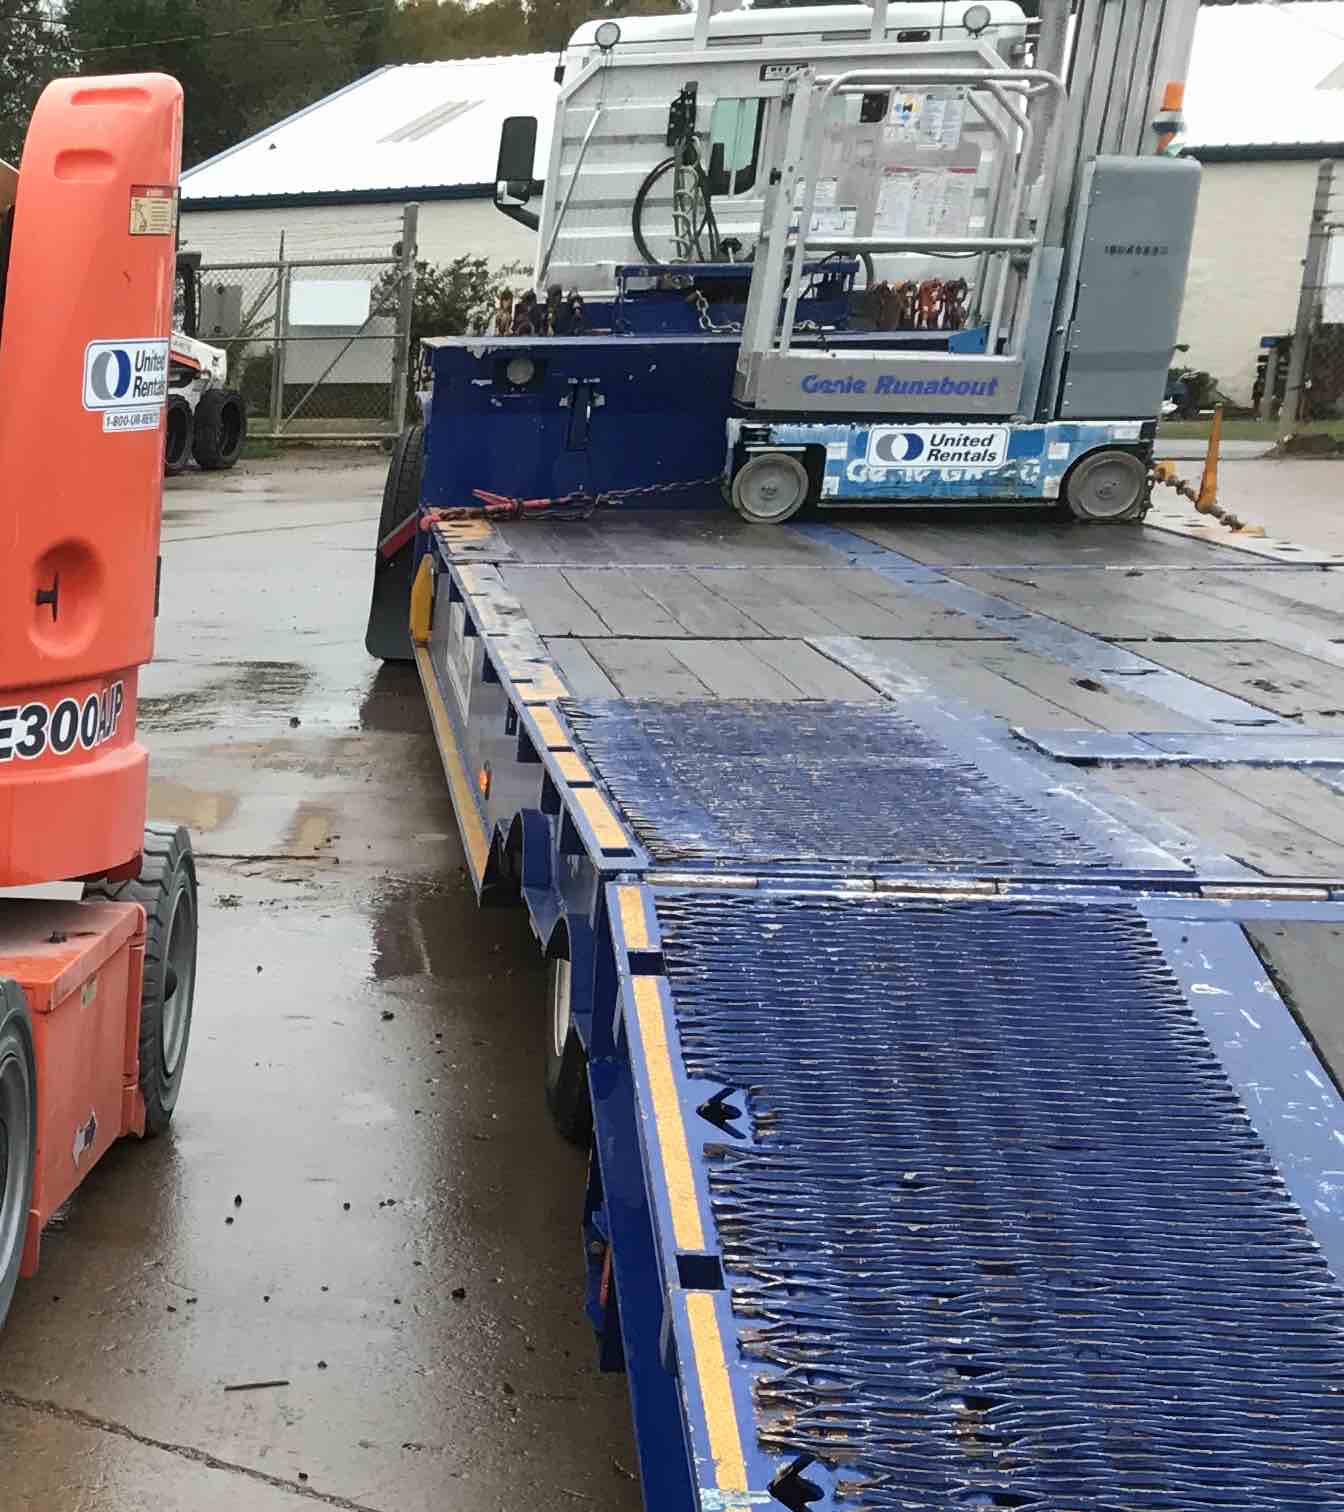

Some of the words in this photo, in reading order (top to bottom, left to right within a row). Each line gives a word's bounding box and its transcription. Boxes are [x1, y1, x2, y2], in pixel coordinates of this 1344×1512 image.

[800, 374, 866, 395] Genie
[874, 376, 999, 397] Runabout
[929, 432, 994, 449] United
[926, 447, 998, 464] Rentals
